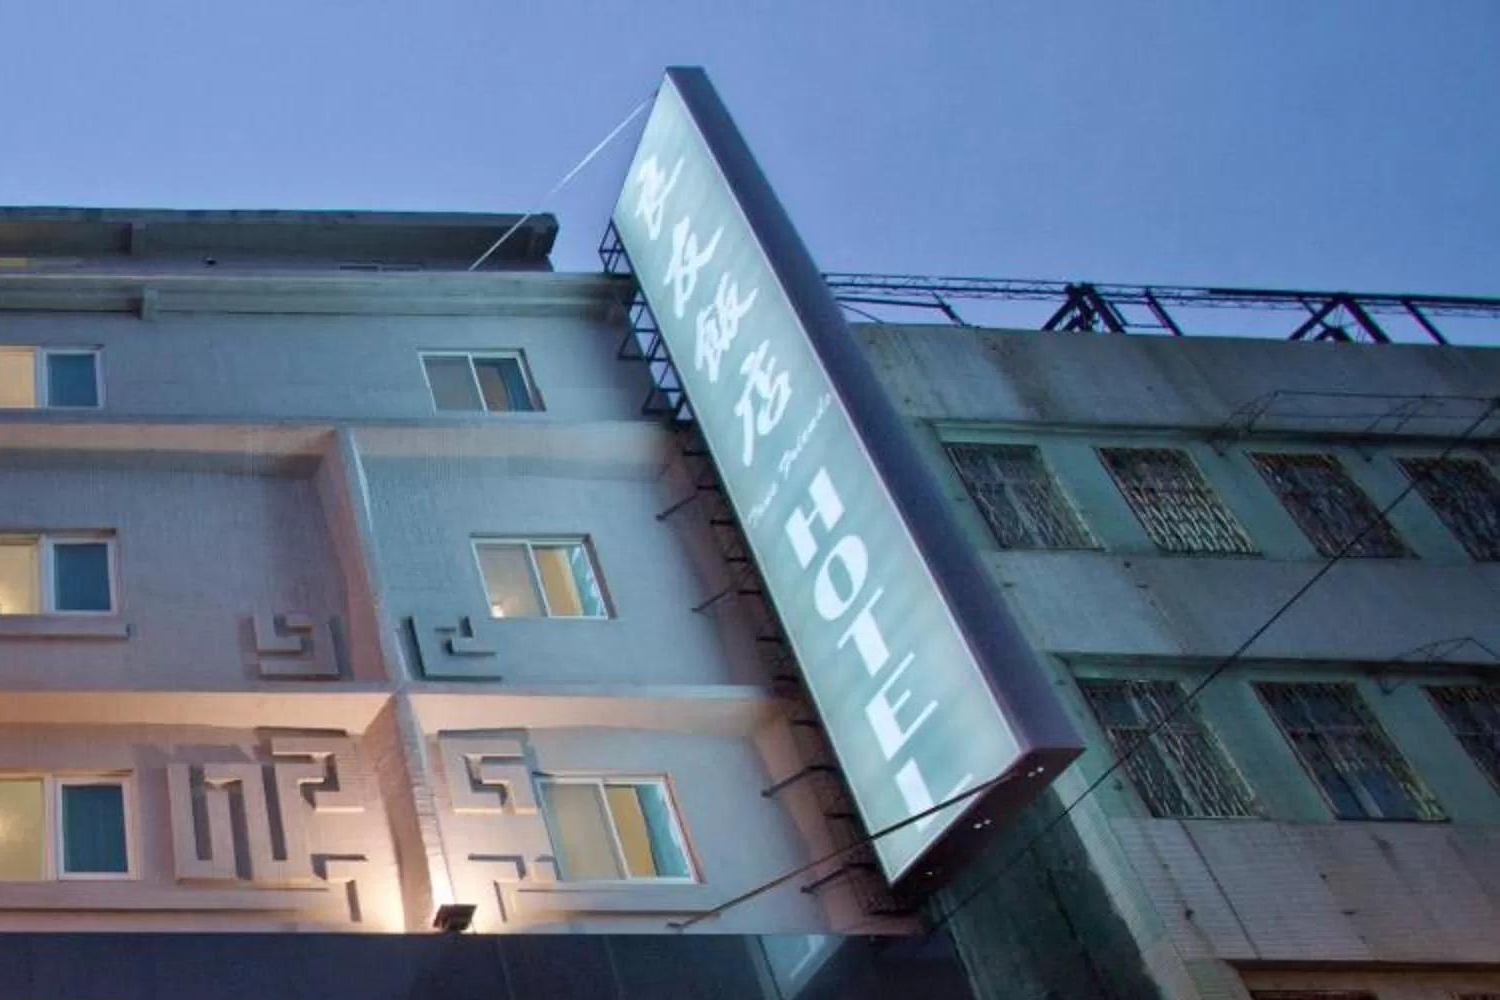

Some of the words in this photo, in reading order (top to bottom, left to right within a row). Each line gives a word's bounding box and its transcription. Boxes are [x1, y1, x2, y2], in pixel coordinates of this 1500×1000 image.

[633, 153, 793, 468] 良友飯店
[783, 466, 974, 834] HOTEL
